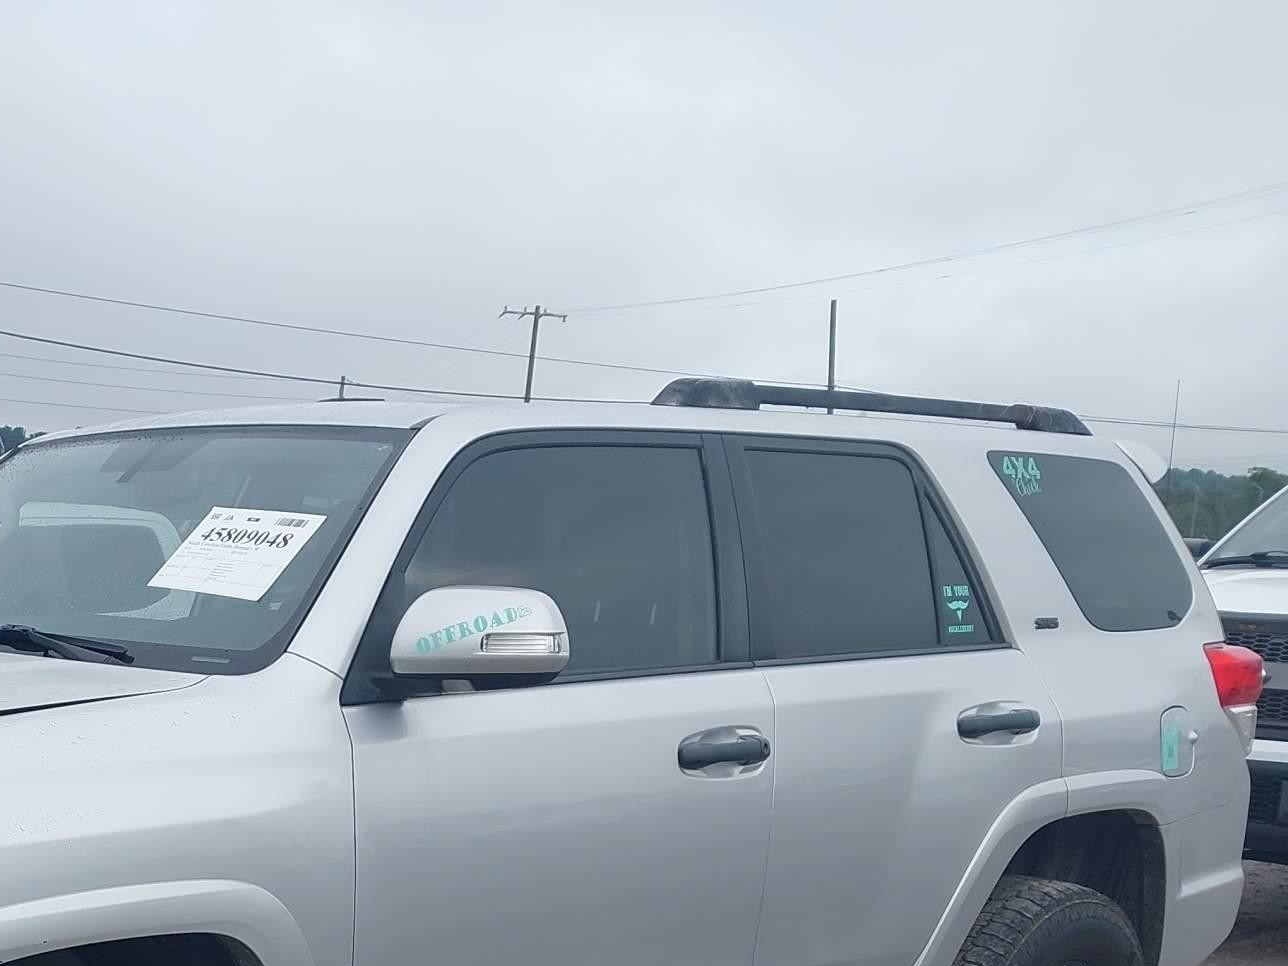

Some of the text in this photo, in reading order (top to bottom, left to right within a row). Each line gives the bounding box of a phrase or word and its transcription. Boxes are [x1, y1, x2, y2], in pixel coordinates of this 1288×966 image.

[1002, 455, 1041, 479] 4X4
[201, 527, 295, 549] 45809048
[416, 606, 519, 655] OFFROAD
